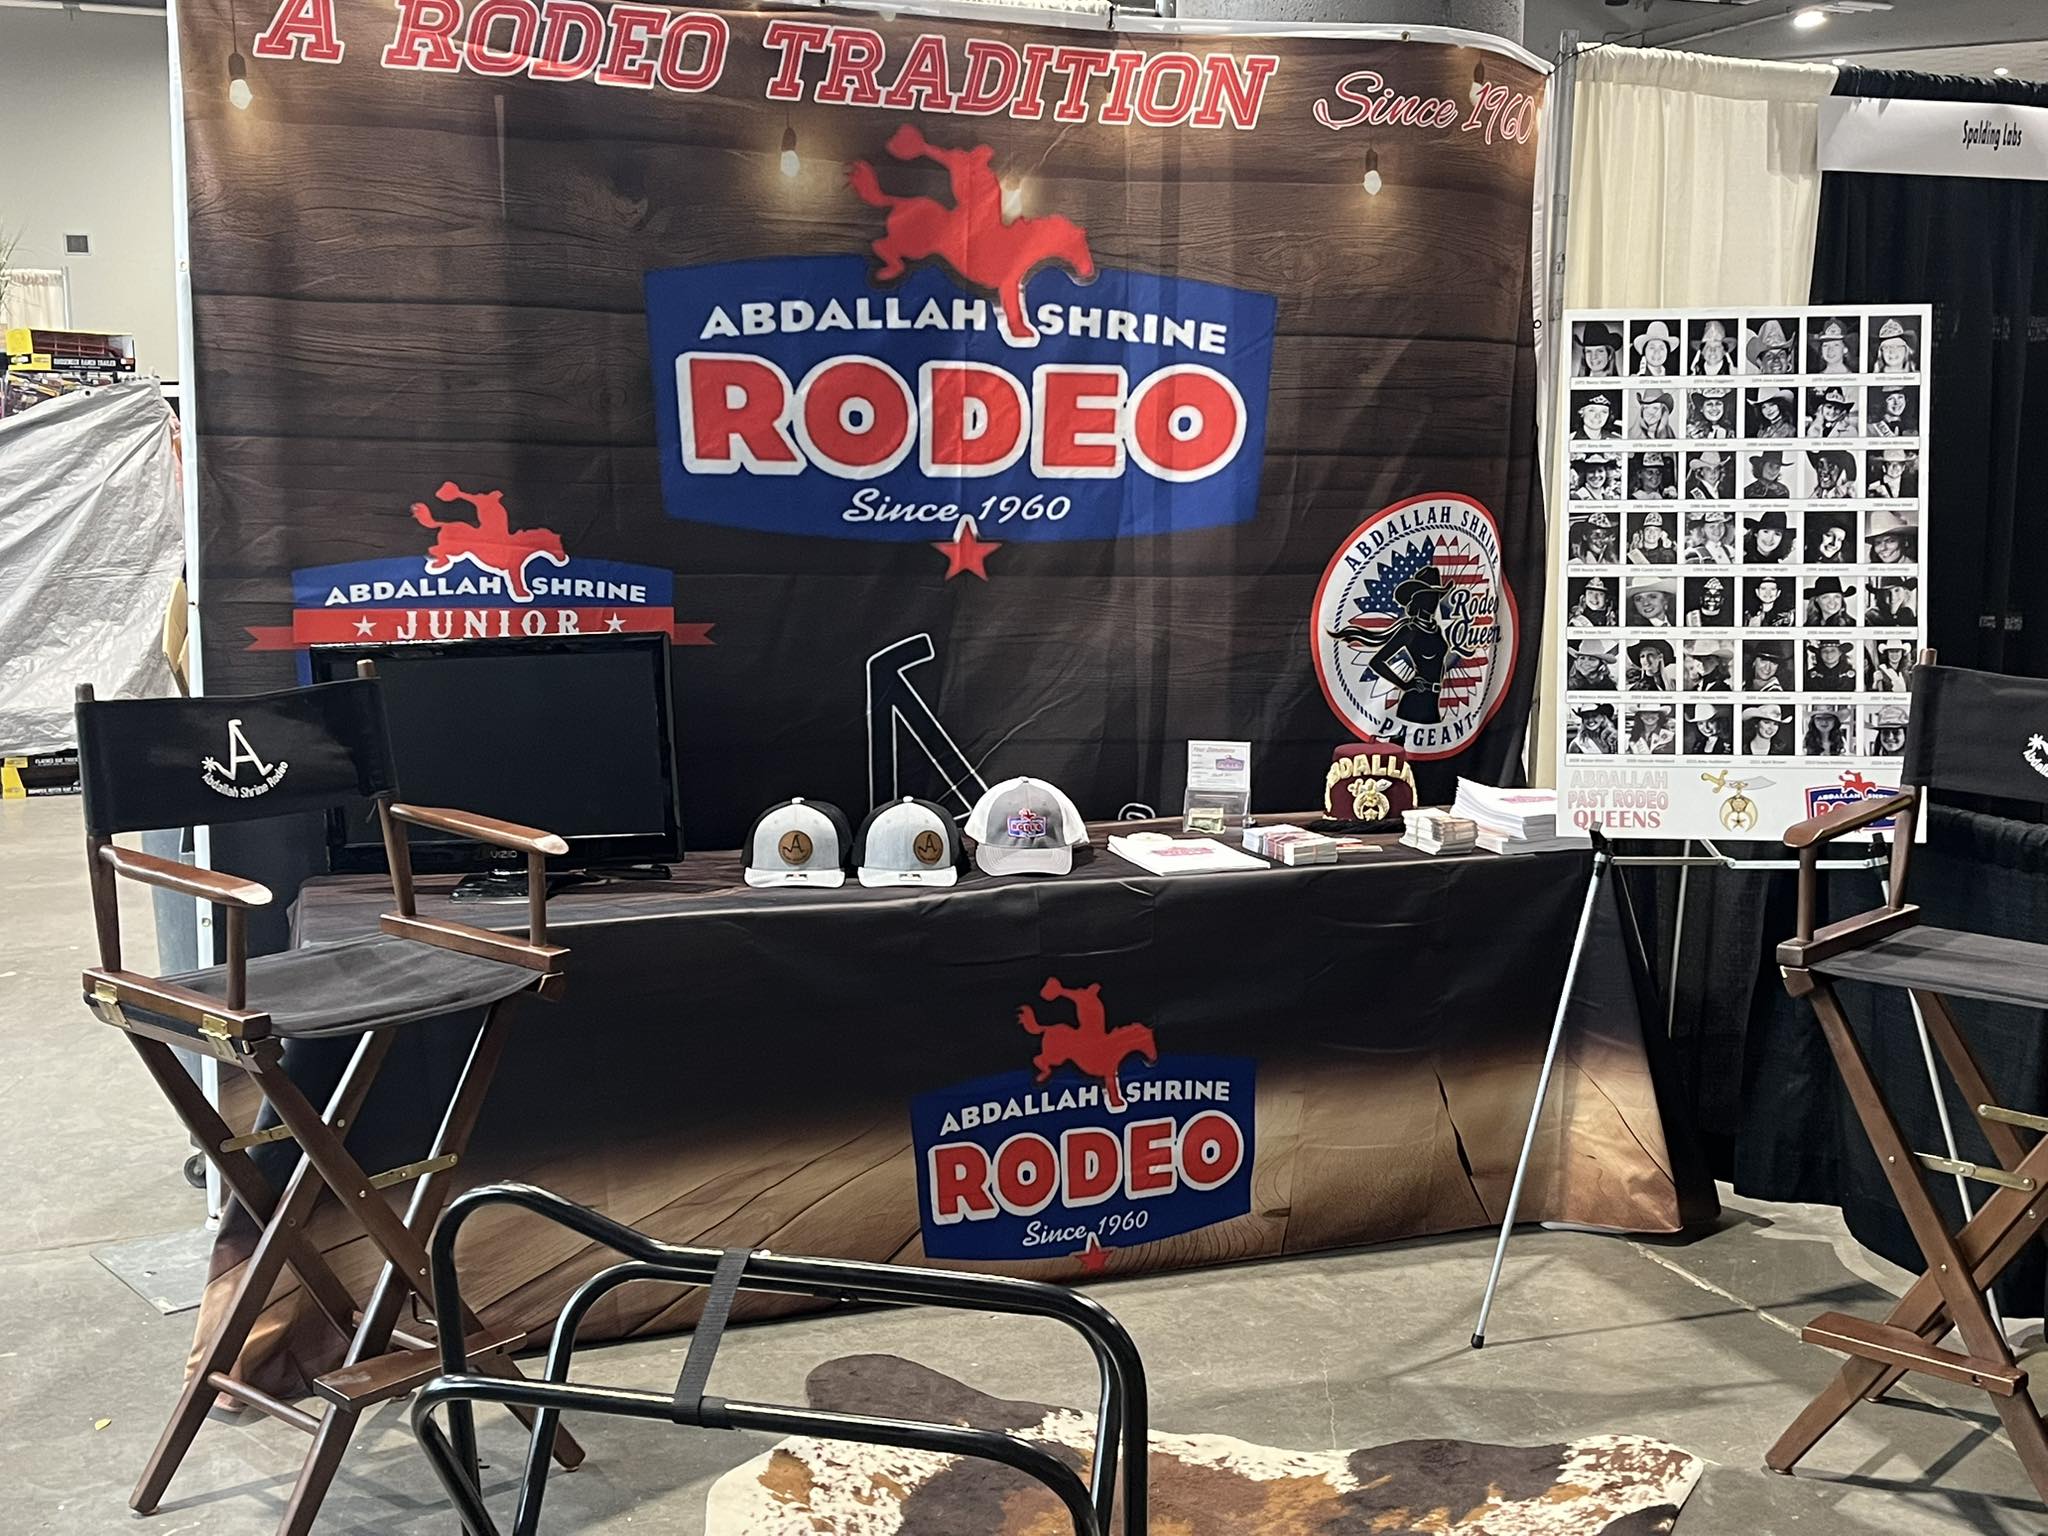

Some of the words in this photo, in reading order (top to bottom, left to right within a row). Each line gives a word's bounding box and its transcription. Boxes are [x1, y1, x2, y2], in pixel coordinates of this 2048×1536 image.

[252, 0, 345, 64] A
[380, 0, 729, 93] RODEO
[764, 20, 1279, 130] TRADITION
[1313, 70, 1458, 130] Since
[1462, 81, 1537, 145] 1960
[1962, 120, 2001, 151] Spalding
[700, 297, 988, 341] ABDALLAH
[1038, 302, 1228, 355] SHRINE
[675, 351, 1247, 483] RODEO
[842, 488, 959, 522] Since
[978, 494, 1072, 524] 1960
[1345, 506, 1451, 572] ABDALLAH
[1460, 510, 1499, 569] SHRINE
[324, 575, 502, 607] ABDALLAH
[533, 576, 647, 604] SHRINE
[1450, 588, 1499, 624] Rodeo
[397, 609, 581, 640] JUNIOR
[1451, 619, 1501, 657] Queen
[1379, 712, 1472, 746] PAGEANT
[202, 772, 239, 797] Abdallah
[240, 783, 269, 798] Shrine
[266, 761, 289, 788] Rodeo
[1570, 769, 1669, 789] ABDALLAH
[1567, 789, 1609, 810] PAST
[1612, 789, 1669, 811] RODEO
[1573, 809, 1661, 831] QUEENS
[939, 1085, 1099, 1137] ABDALLAH
[1126, 1080, 1230, 1103] SHRINE
[927, 1109, 1245, 1226] RODEO
[1022, 1220, 1087, 1247] Since
[1097, 1210, 1149, 1235] 1960
